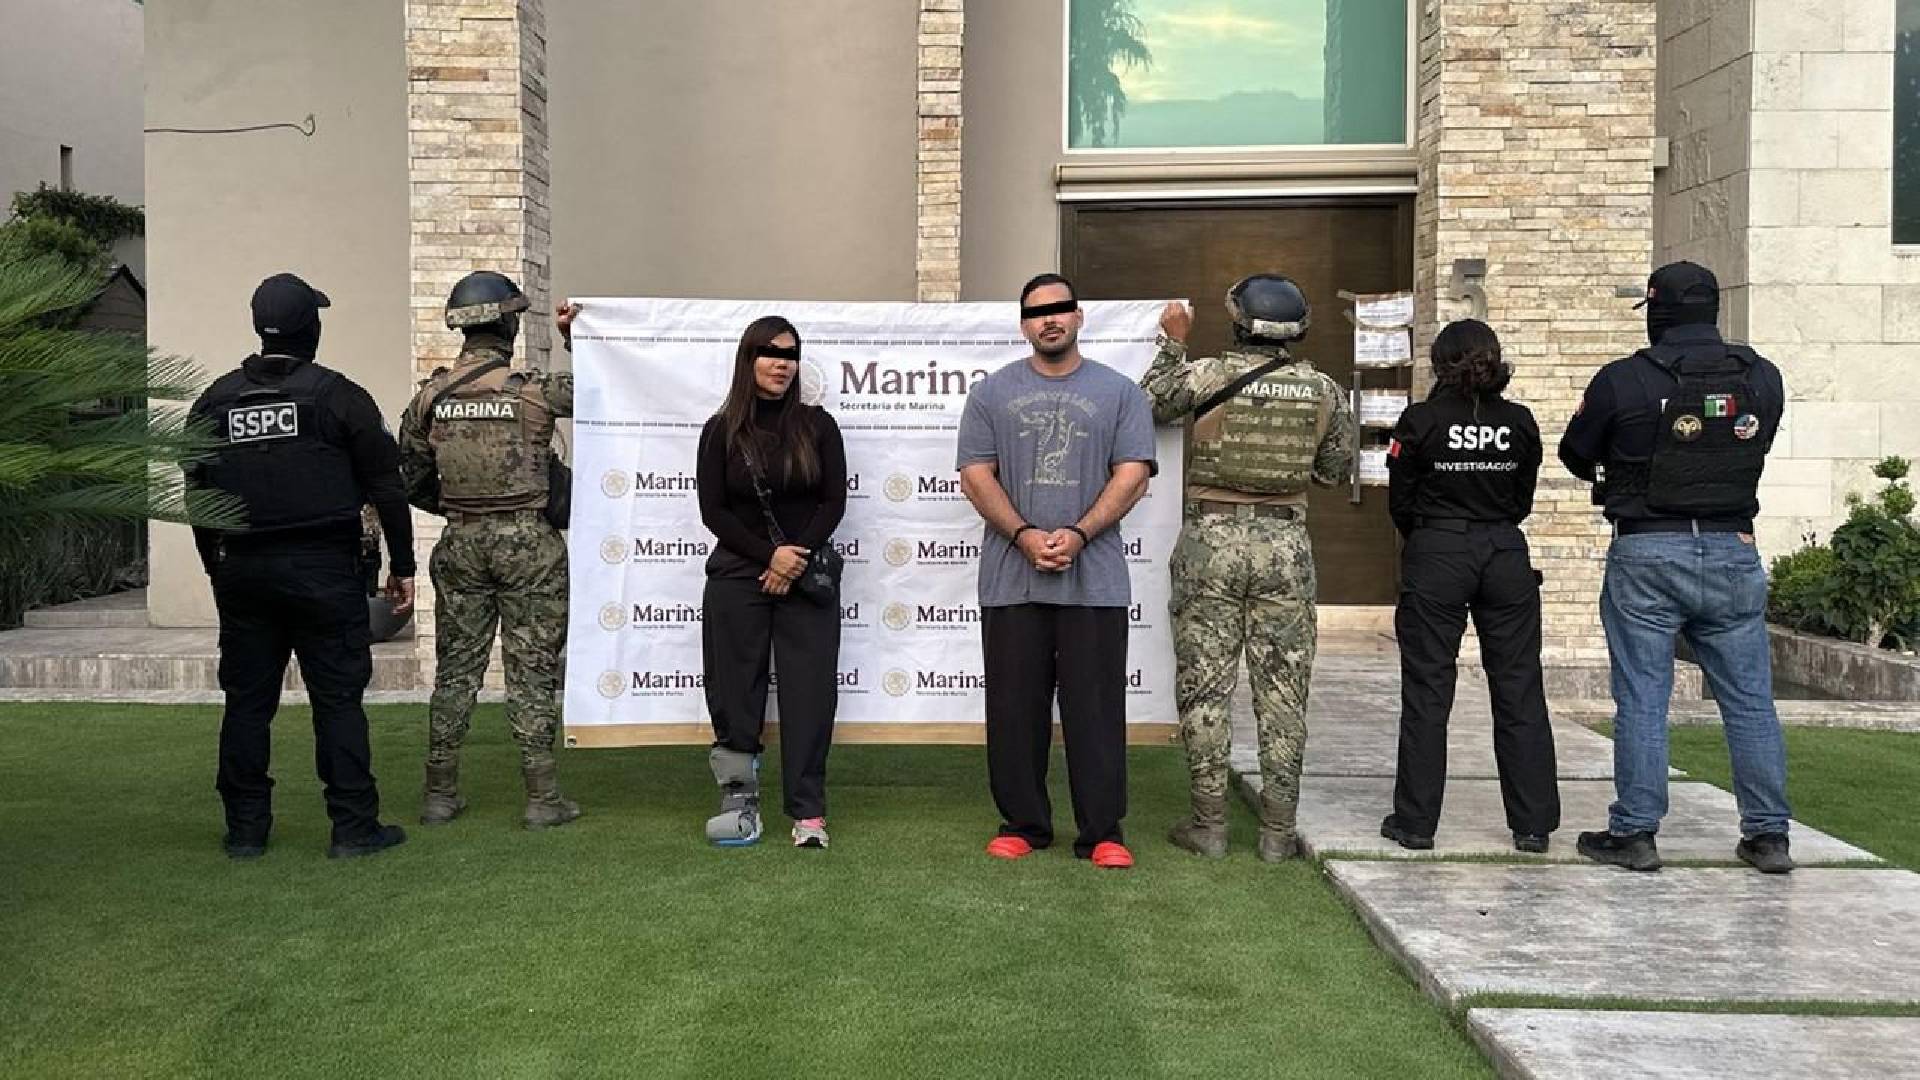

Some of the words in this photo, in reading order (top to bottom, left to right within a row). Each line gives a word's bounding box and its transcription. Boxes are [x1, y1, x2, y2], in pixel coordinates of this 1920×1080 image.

[1242, 381, 1312, 398] MARINA
[435, 402, 514, 418] MARINA
[231, 407, 294, 437] SSPC
[1448, 424, 1511, 451] SSPC
[635, 471, 697, 490] Marin
[918, 475, 961, 493] Mar
[634, 537, 709, 556] Marina
[917, 540, 981, 558] Marin
[917, 604, 981, 622] Marin
